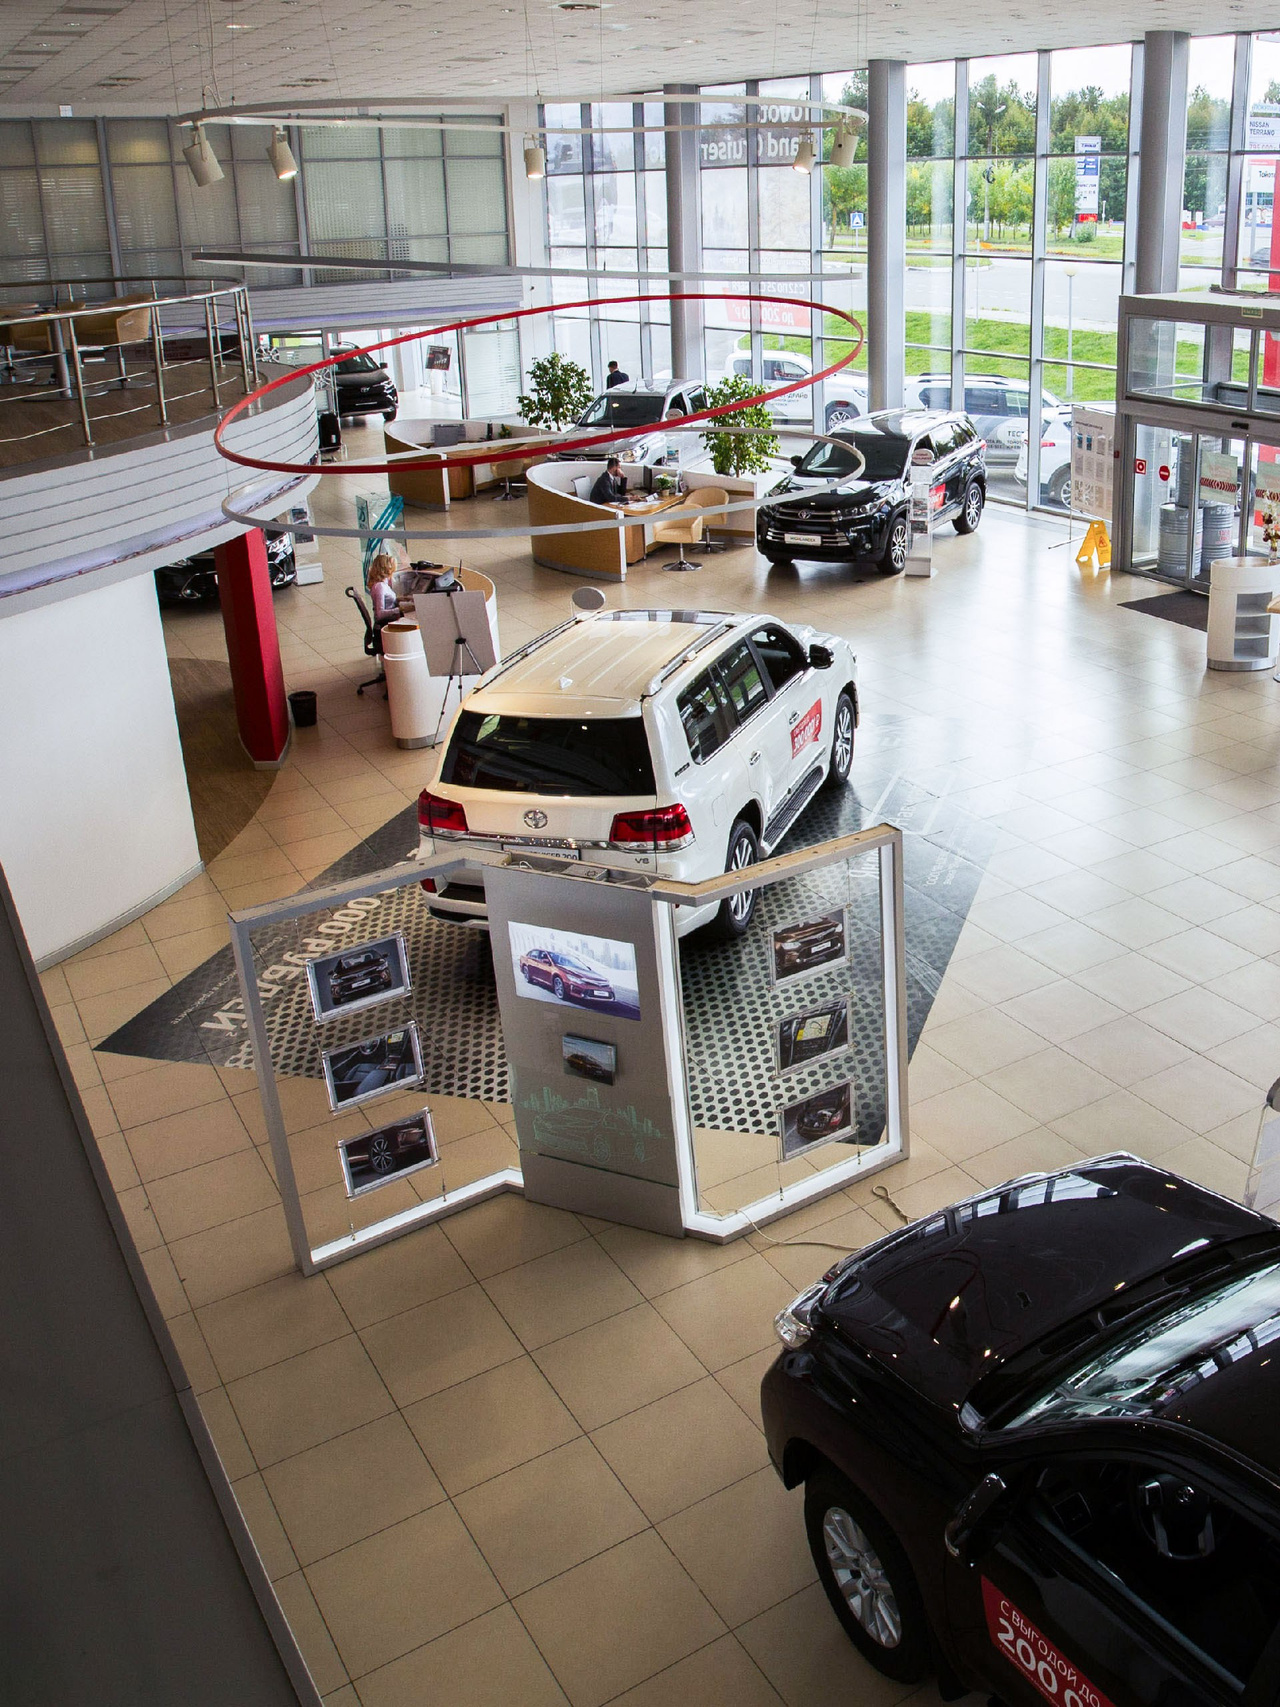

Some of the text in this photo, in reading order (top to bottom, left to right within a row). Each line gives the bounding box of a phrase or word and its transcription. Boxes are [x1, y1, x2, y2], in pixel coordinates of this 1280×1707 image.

[1249, 128, 1275, 136] TERRANO
[997, 1617, 1058, 1694] 200
[1000, 1600, 1100, 1707] С ВЫГОДОЙ ДО
